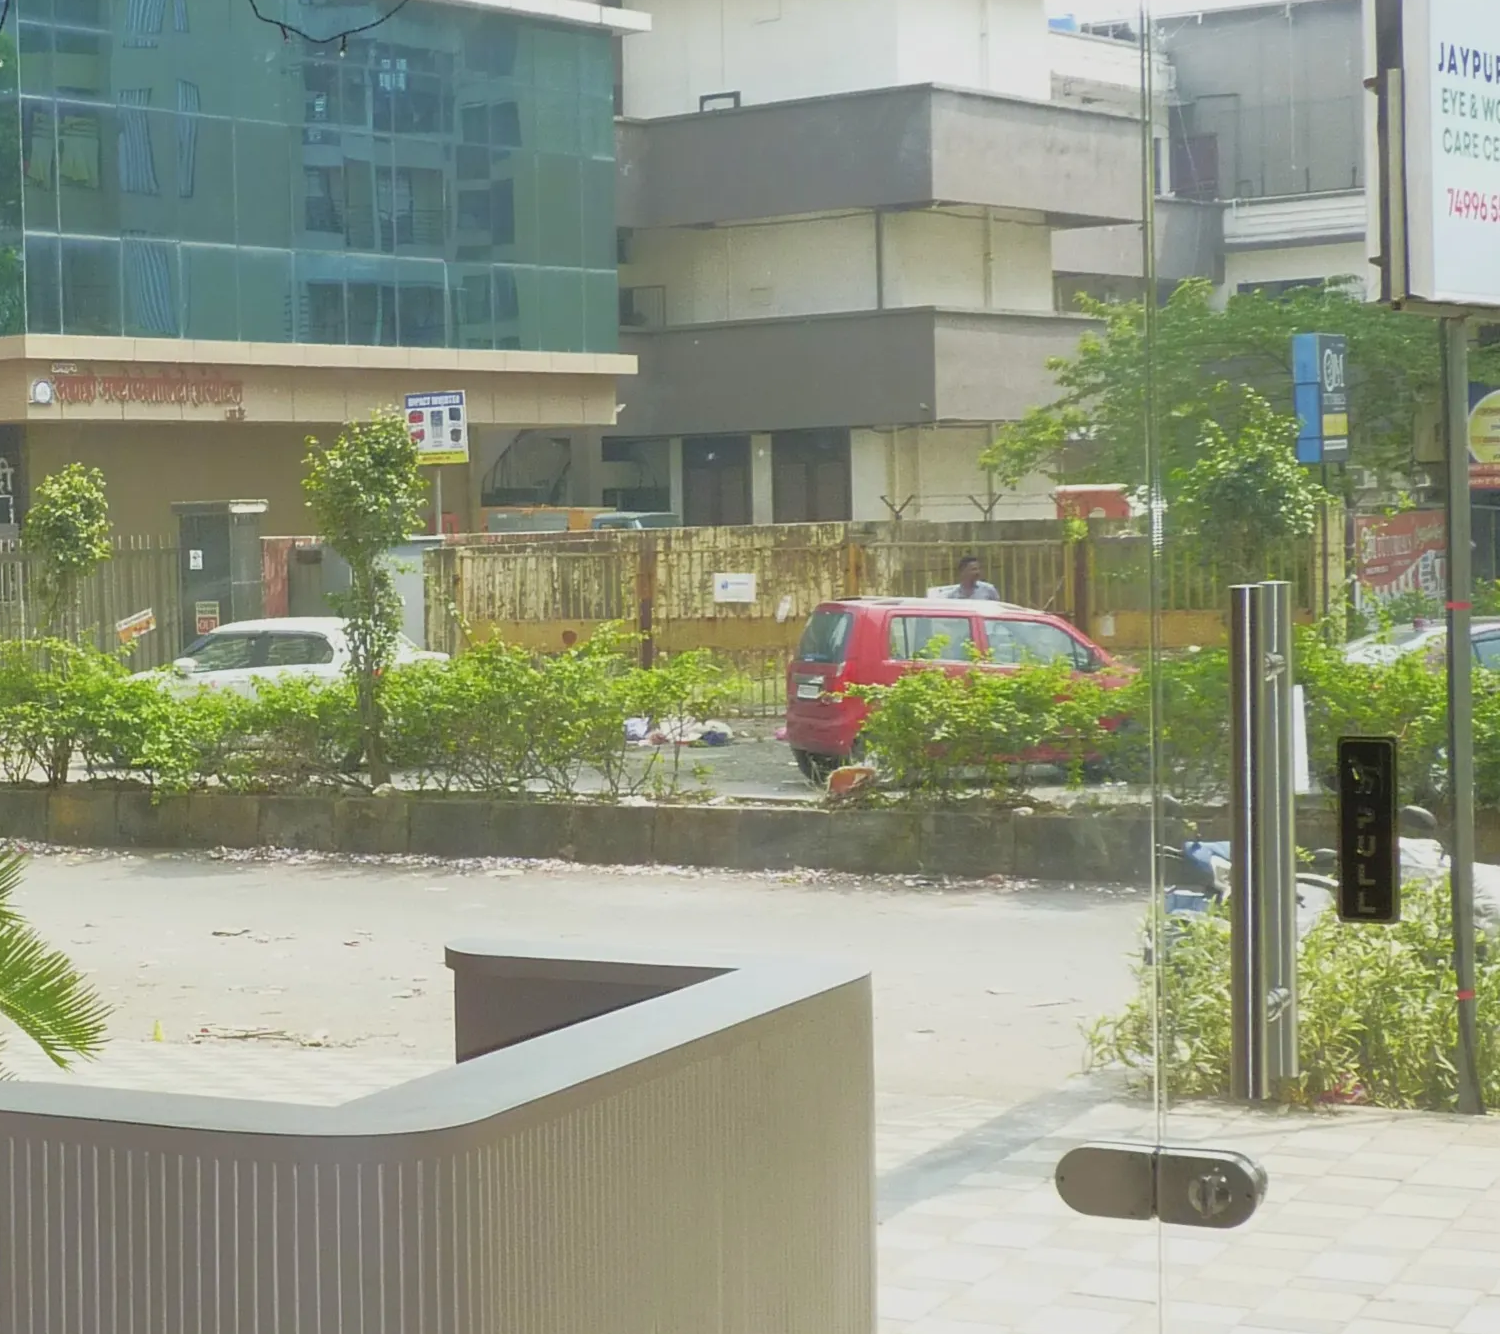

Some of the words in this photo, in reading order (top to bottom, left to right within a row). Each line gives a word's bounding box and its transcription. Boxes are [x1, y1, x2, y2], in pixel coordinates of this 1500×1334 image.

[1442, 87, 1466, 118] EYE
[1471, 93, 1478, 119] &
[1443, 127, 1479, 159] CARE
[1447, 187, 1487, 221] 74996
[1357, 805, 1376, 914] PULL
